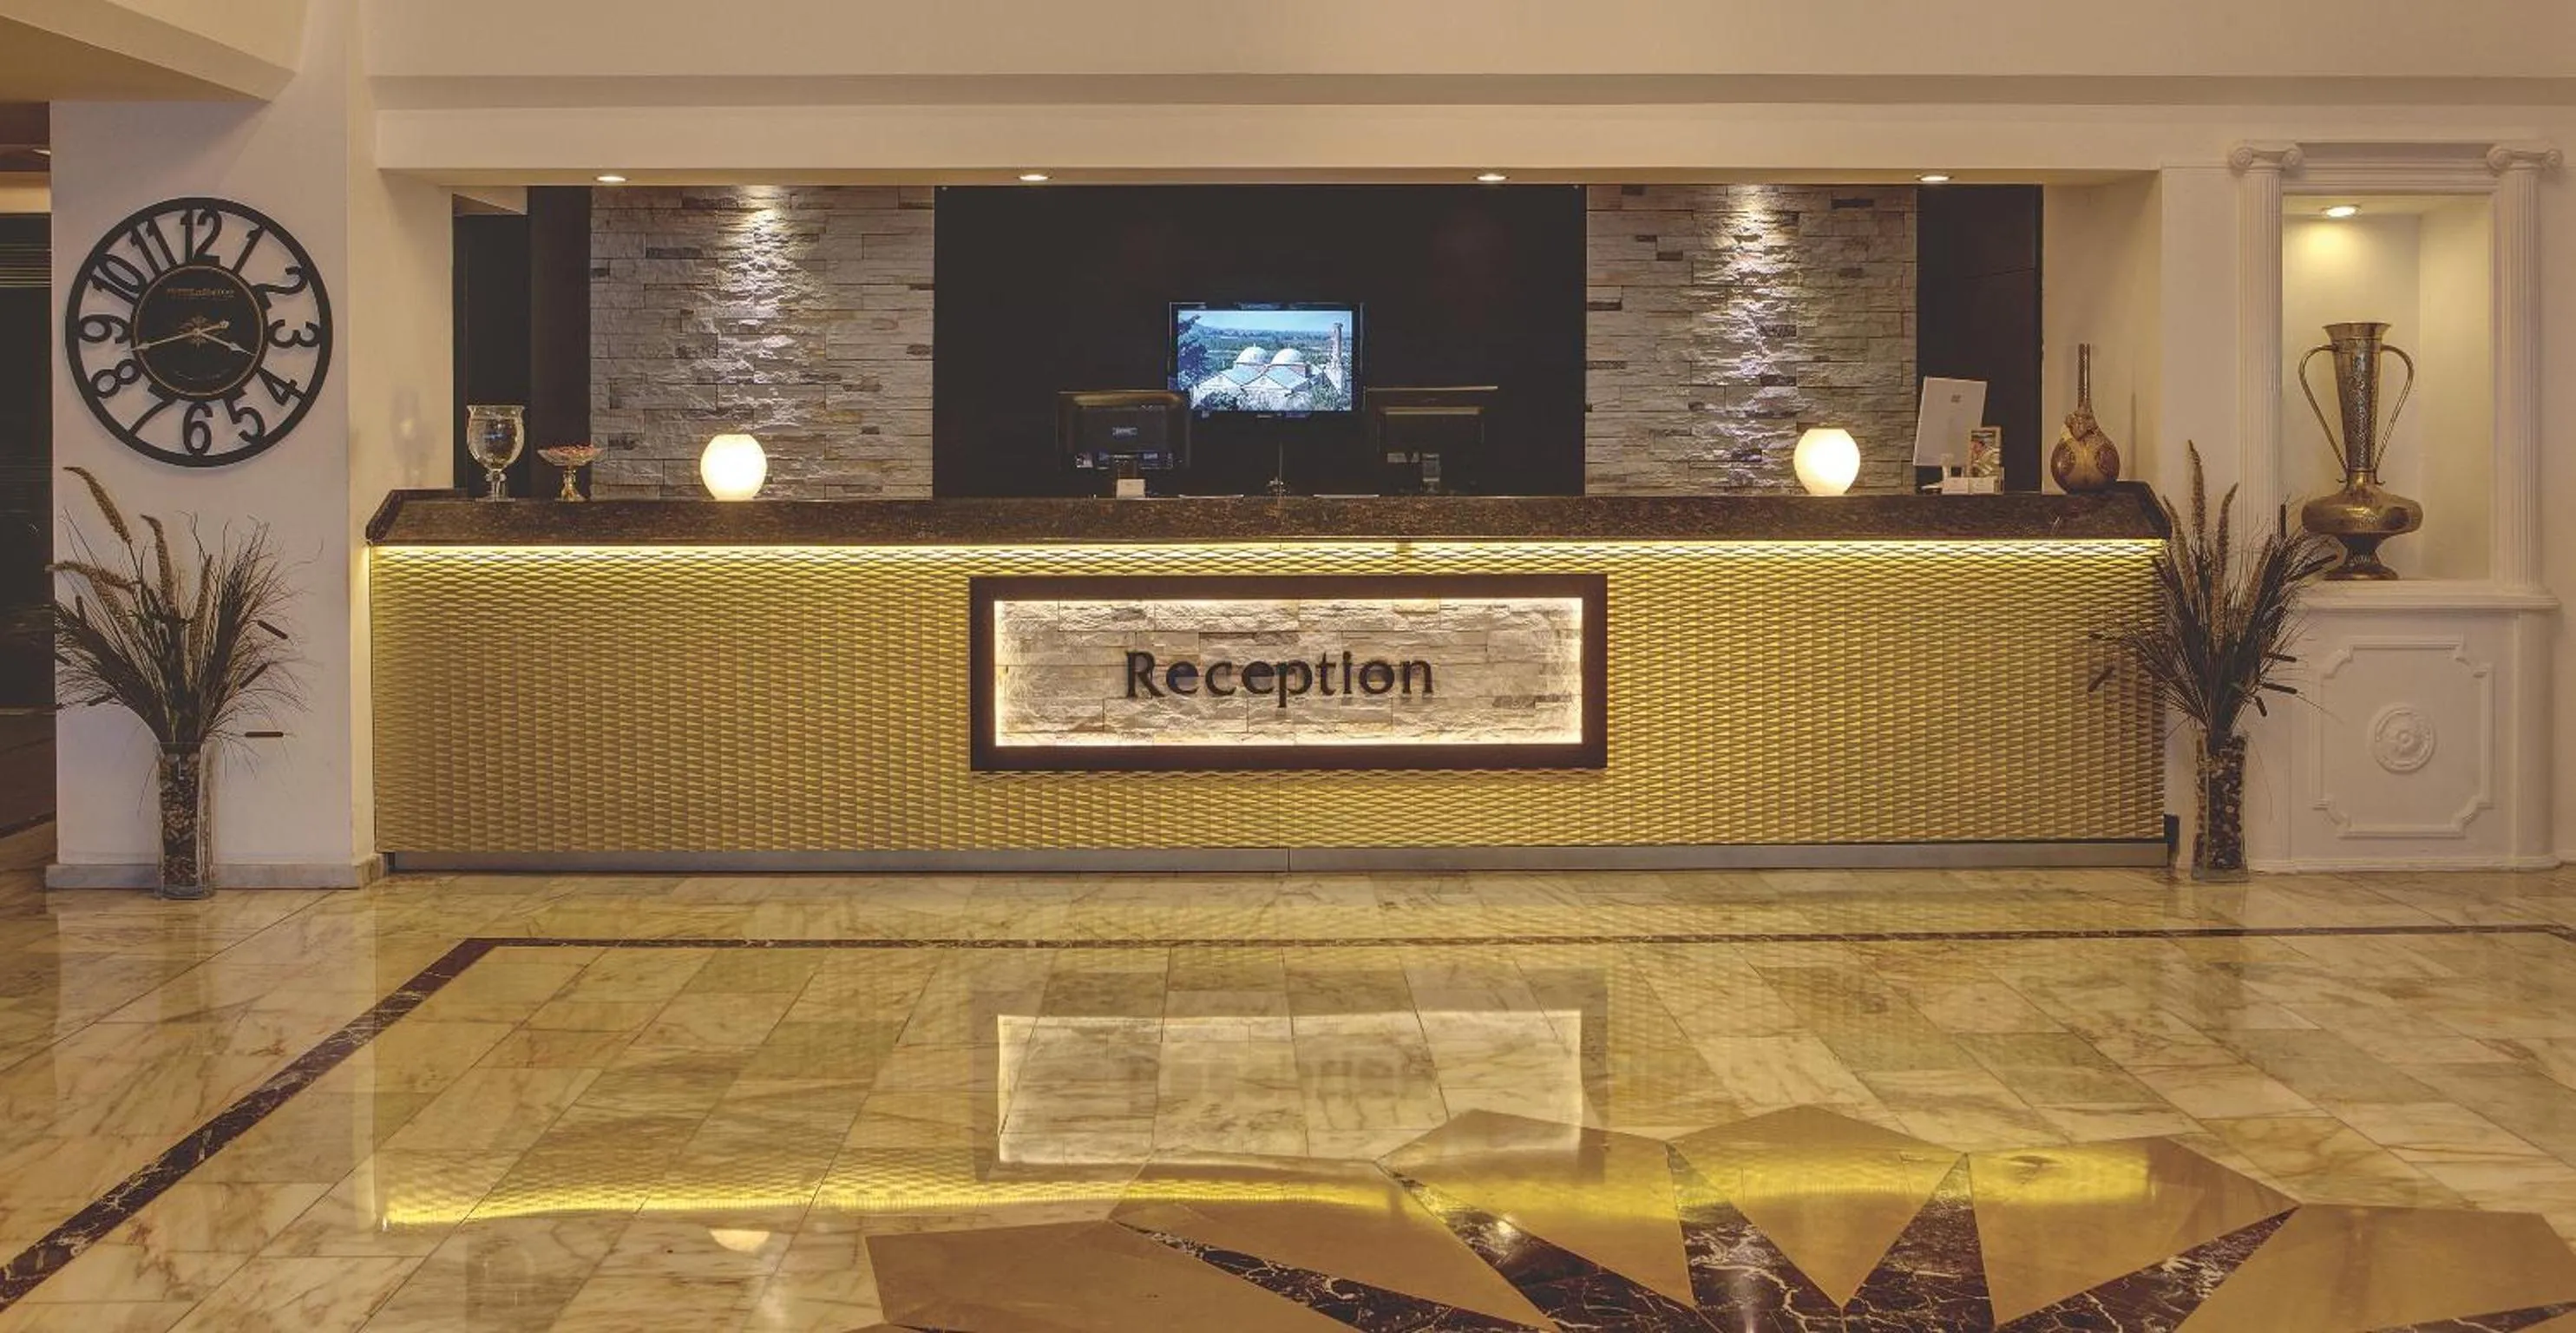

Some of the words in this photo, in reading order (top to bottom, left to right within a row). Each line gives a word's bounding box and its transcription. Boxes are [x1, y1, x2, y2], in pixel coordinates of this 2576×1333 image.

[130, 218, 179, 275] 11
[180, 209, 221, 263] 12
[232, 224, 266, 274] 1
[89, 253, 147, 304] 10
[252, 266, 307, 309] 2
[79, 313, 130, 345] 9
[267, 318, 321, 348] 3
[90, 358, 141, 398] 8
[257, 366, 305, 405] 4
[130, 380, 177, 435] 7
[182, 400, 213, 455] 6
[224, 387, 265, 444] 5
[1124, 650, 1434, 708] Reception
